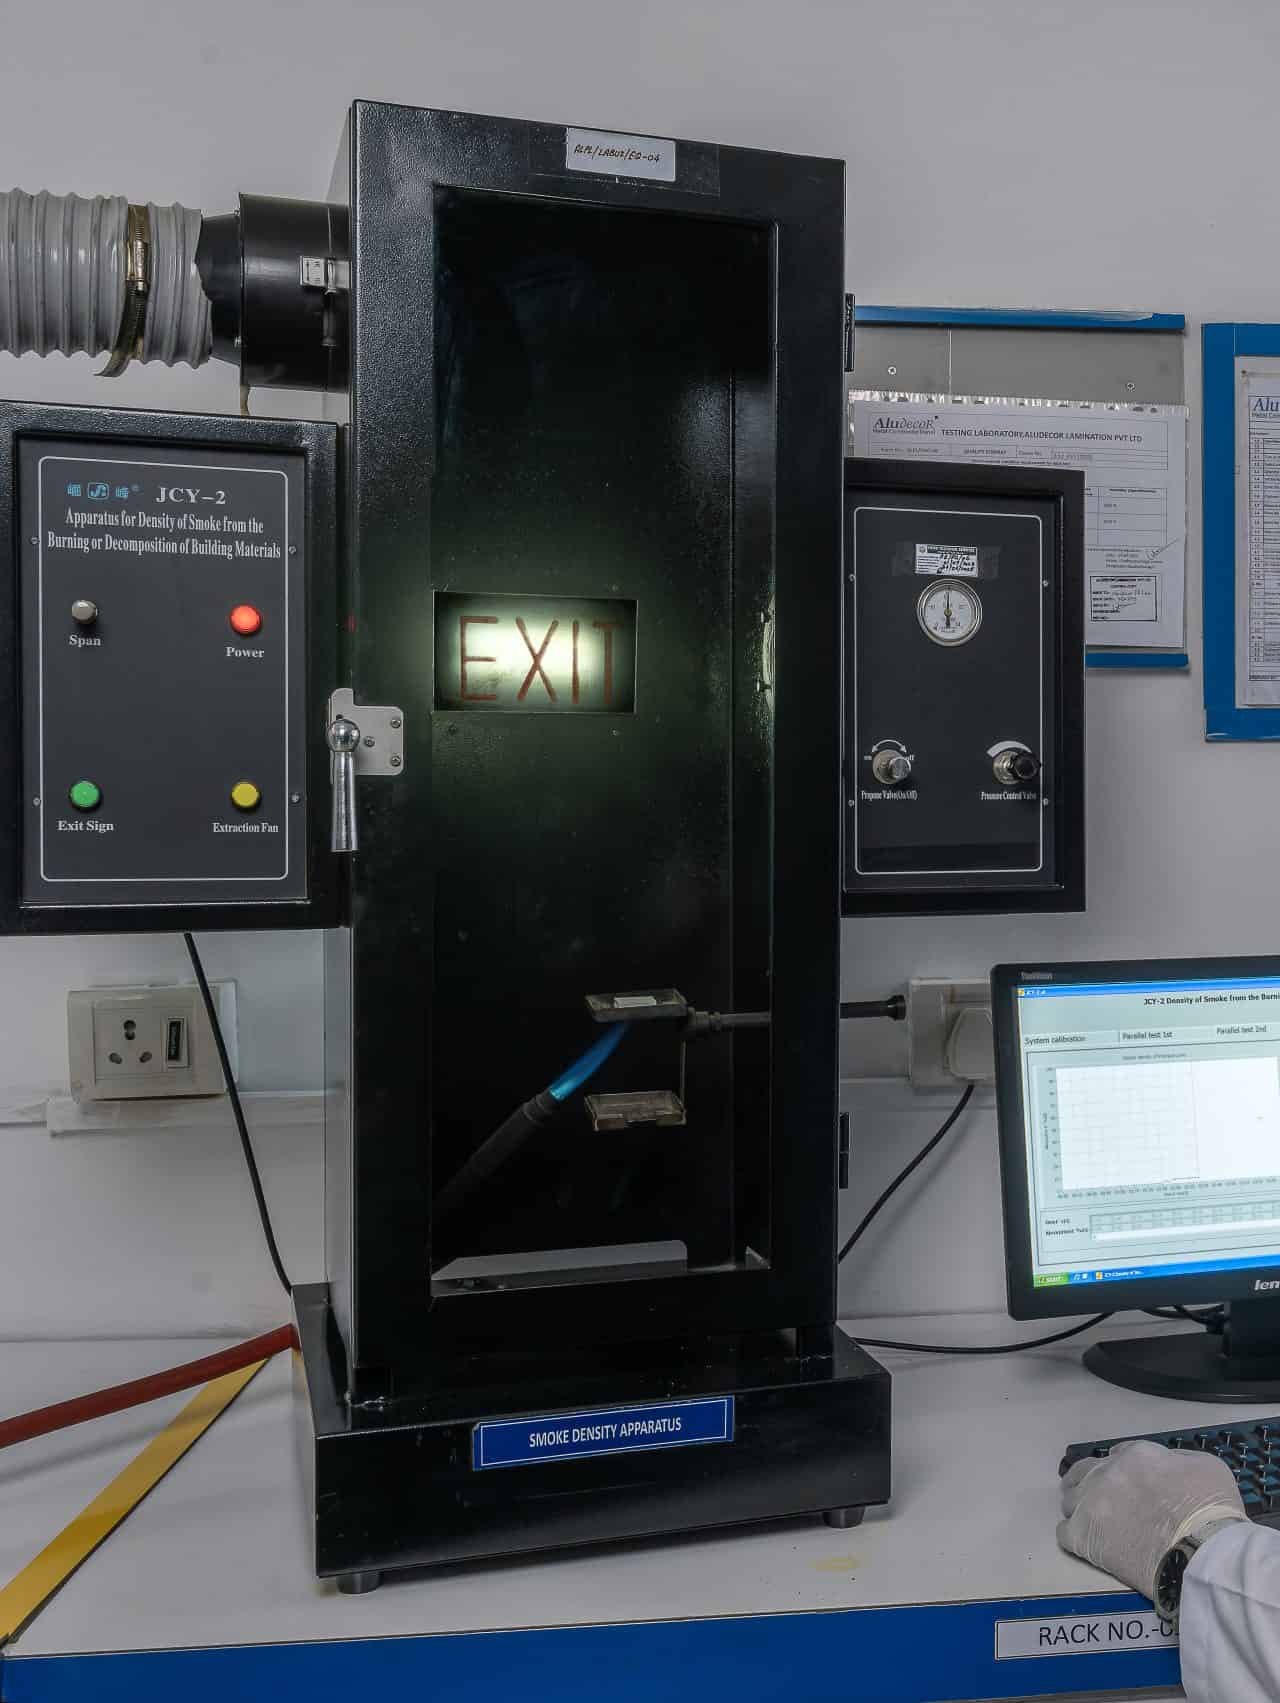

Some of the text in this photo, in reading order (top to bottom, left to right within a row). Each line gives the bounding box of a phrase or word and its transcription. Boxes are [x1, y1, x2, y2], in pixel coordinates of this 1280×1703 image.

[942, 429, 972, 437] TESTING
[1065, 432, 1113, 440] LAMINATION
[65, 507, 264, 533] Apparatus for Density of Smoke from the
[47, 531, 281, 560] Burning or Decomposition of Building Materials
[69, 635, 101, 647] Span
[226, 646, 265, 658] Power
[460, 616, 624, 704] EXIT
[58, 820, 115, 834] Exit Sign
[213, 821, 279, 833] Extraction Fan
[1167, 996, 1193, 1004] Density
[1122, 1032, 1147, 1040] Parallel
[1148, 1031, 1161, 1039] test
[1217, 1026, 1240, 1034] Parallel
[1255, 1025, 1267, 1033] 2nd
[1024, 1035, 1086, 1046] System calibration
[529, 1416, 682, 1449] SMOKE DENSITY APPARATUS
[1039, 1623, 1100, 1647] RACK
